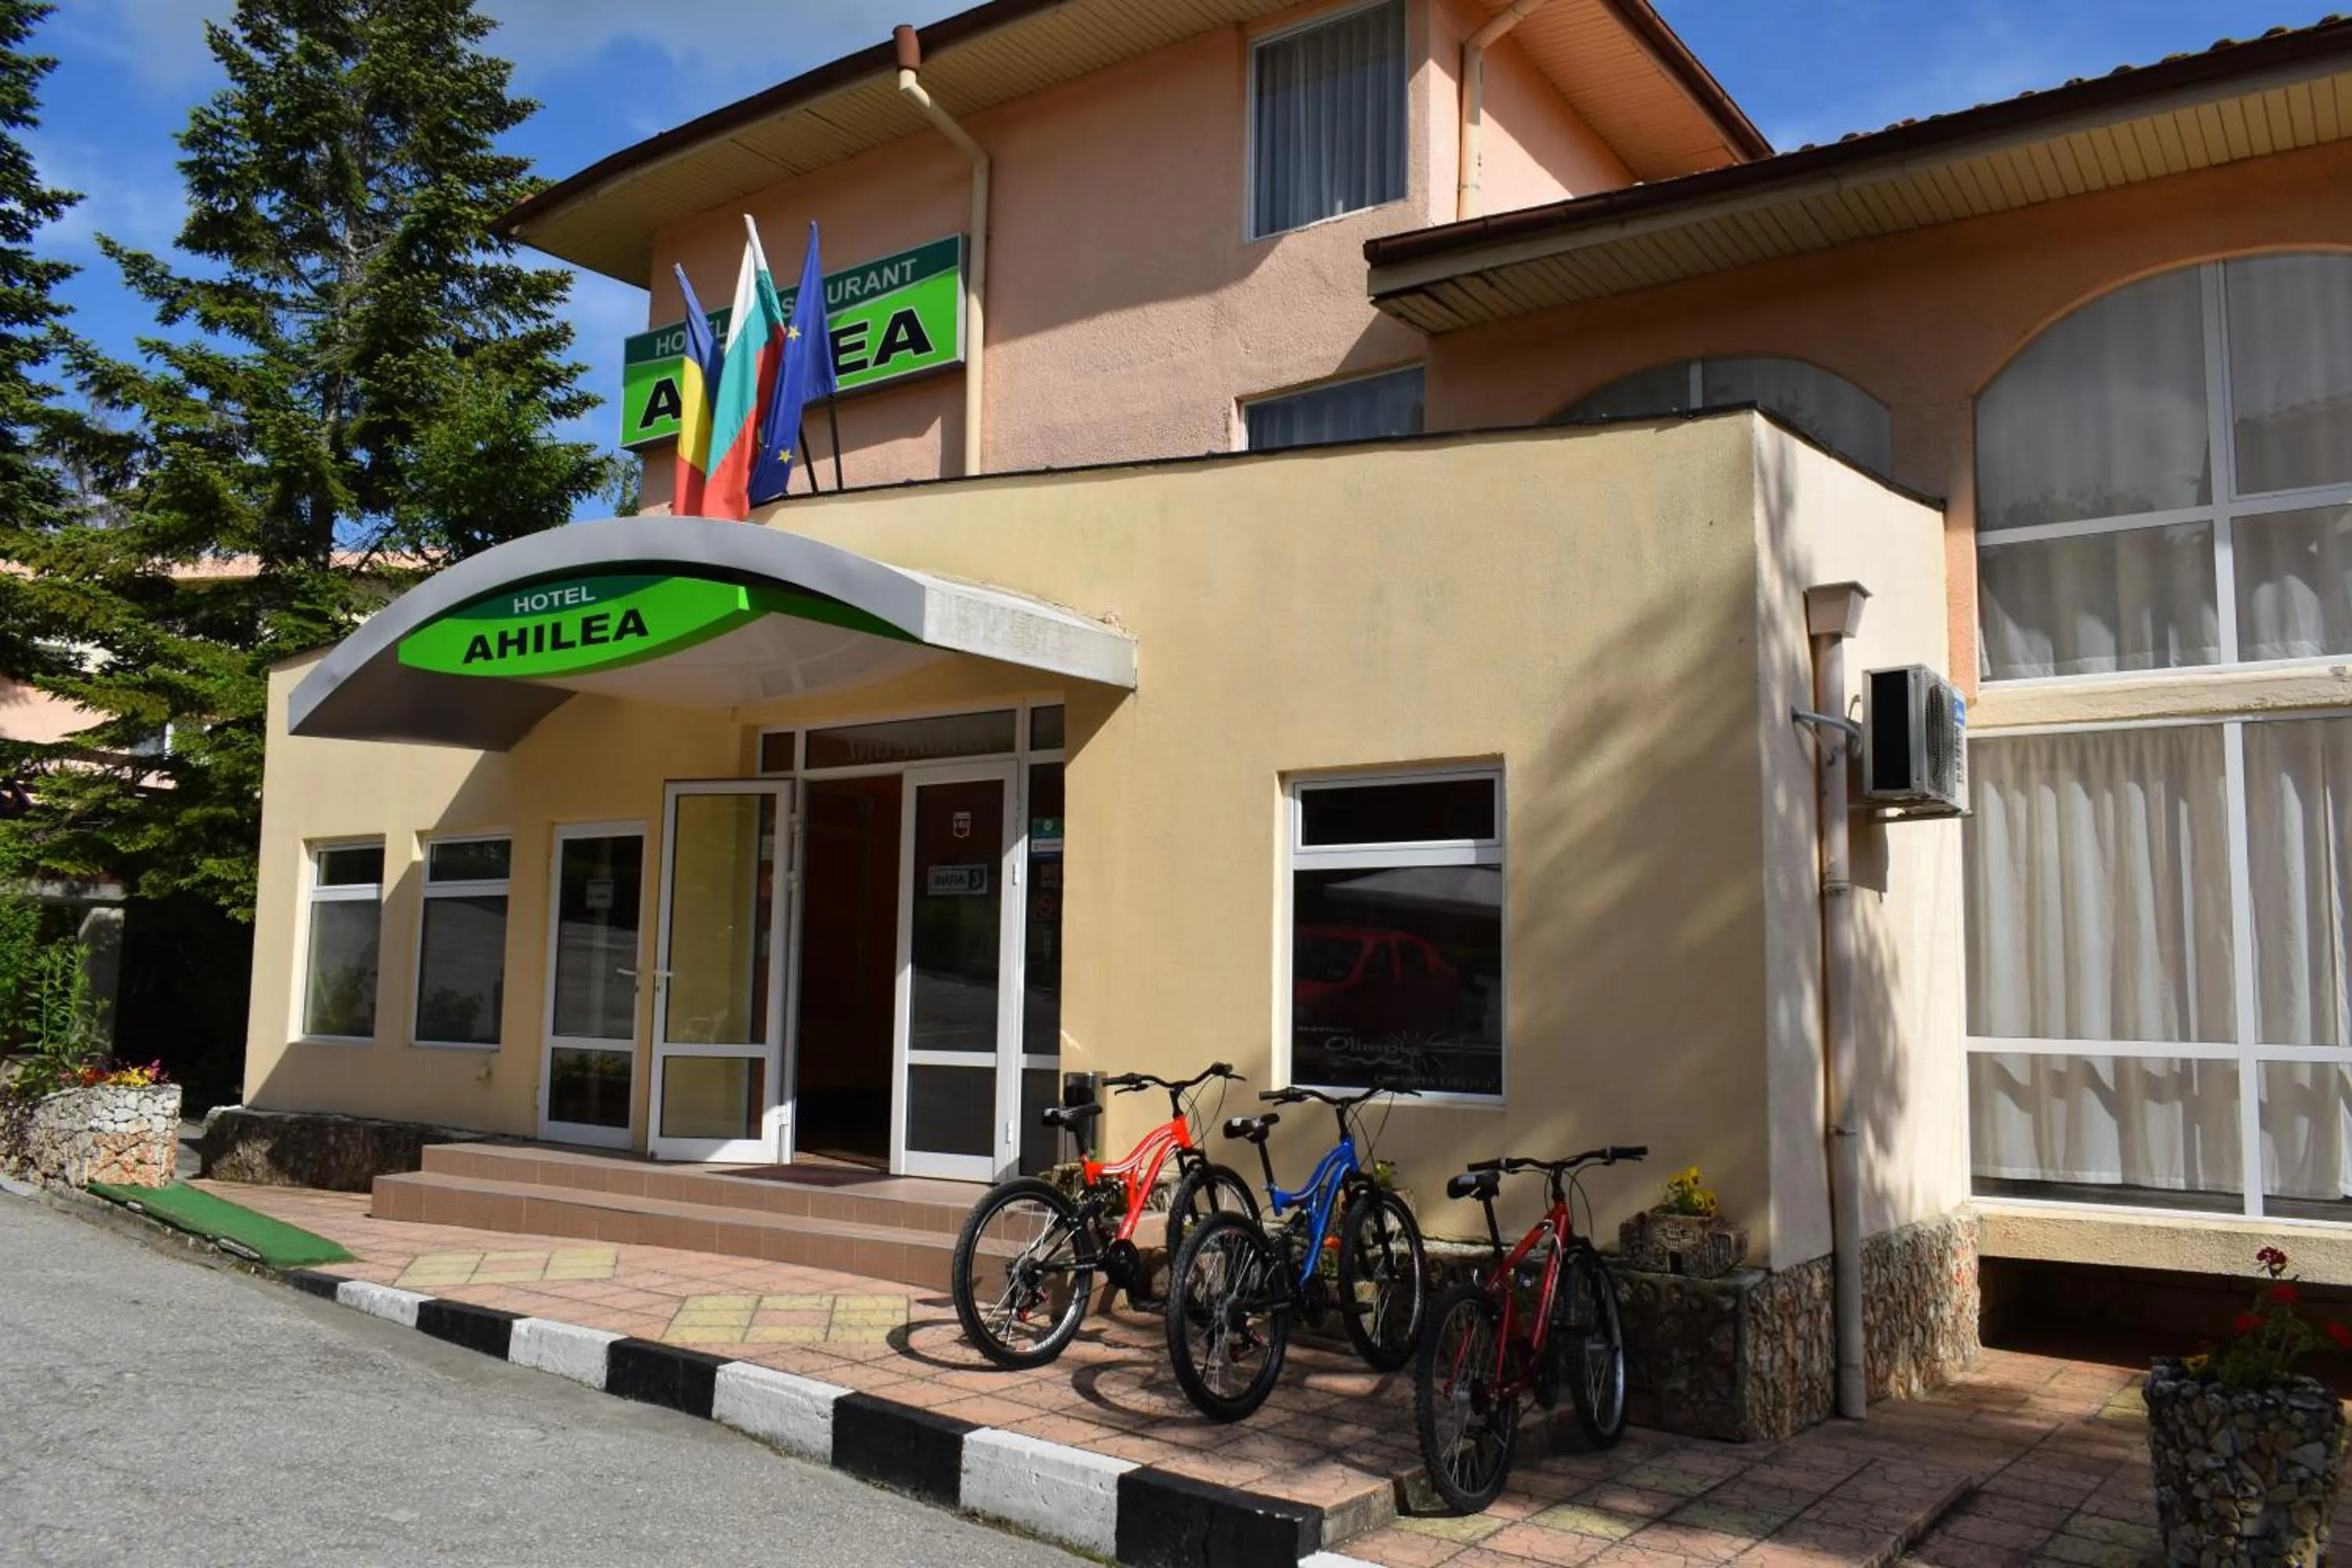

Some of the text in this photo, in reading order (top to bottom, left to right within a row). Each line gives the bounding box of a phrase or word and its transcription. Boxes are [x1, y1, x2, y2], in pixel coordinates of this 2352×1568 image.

[782, 258, 917, 315] SURANT
[638, 307, 934, 430] AEA
[513, 585, 596, 614] HOTEL
[462, 608, 649, 665] AHILEA
